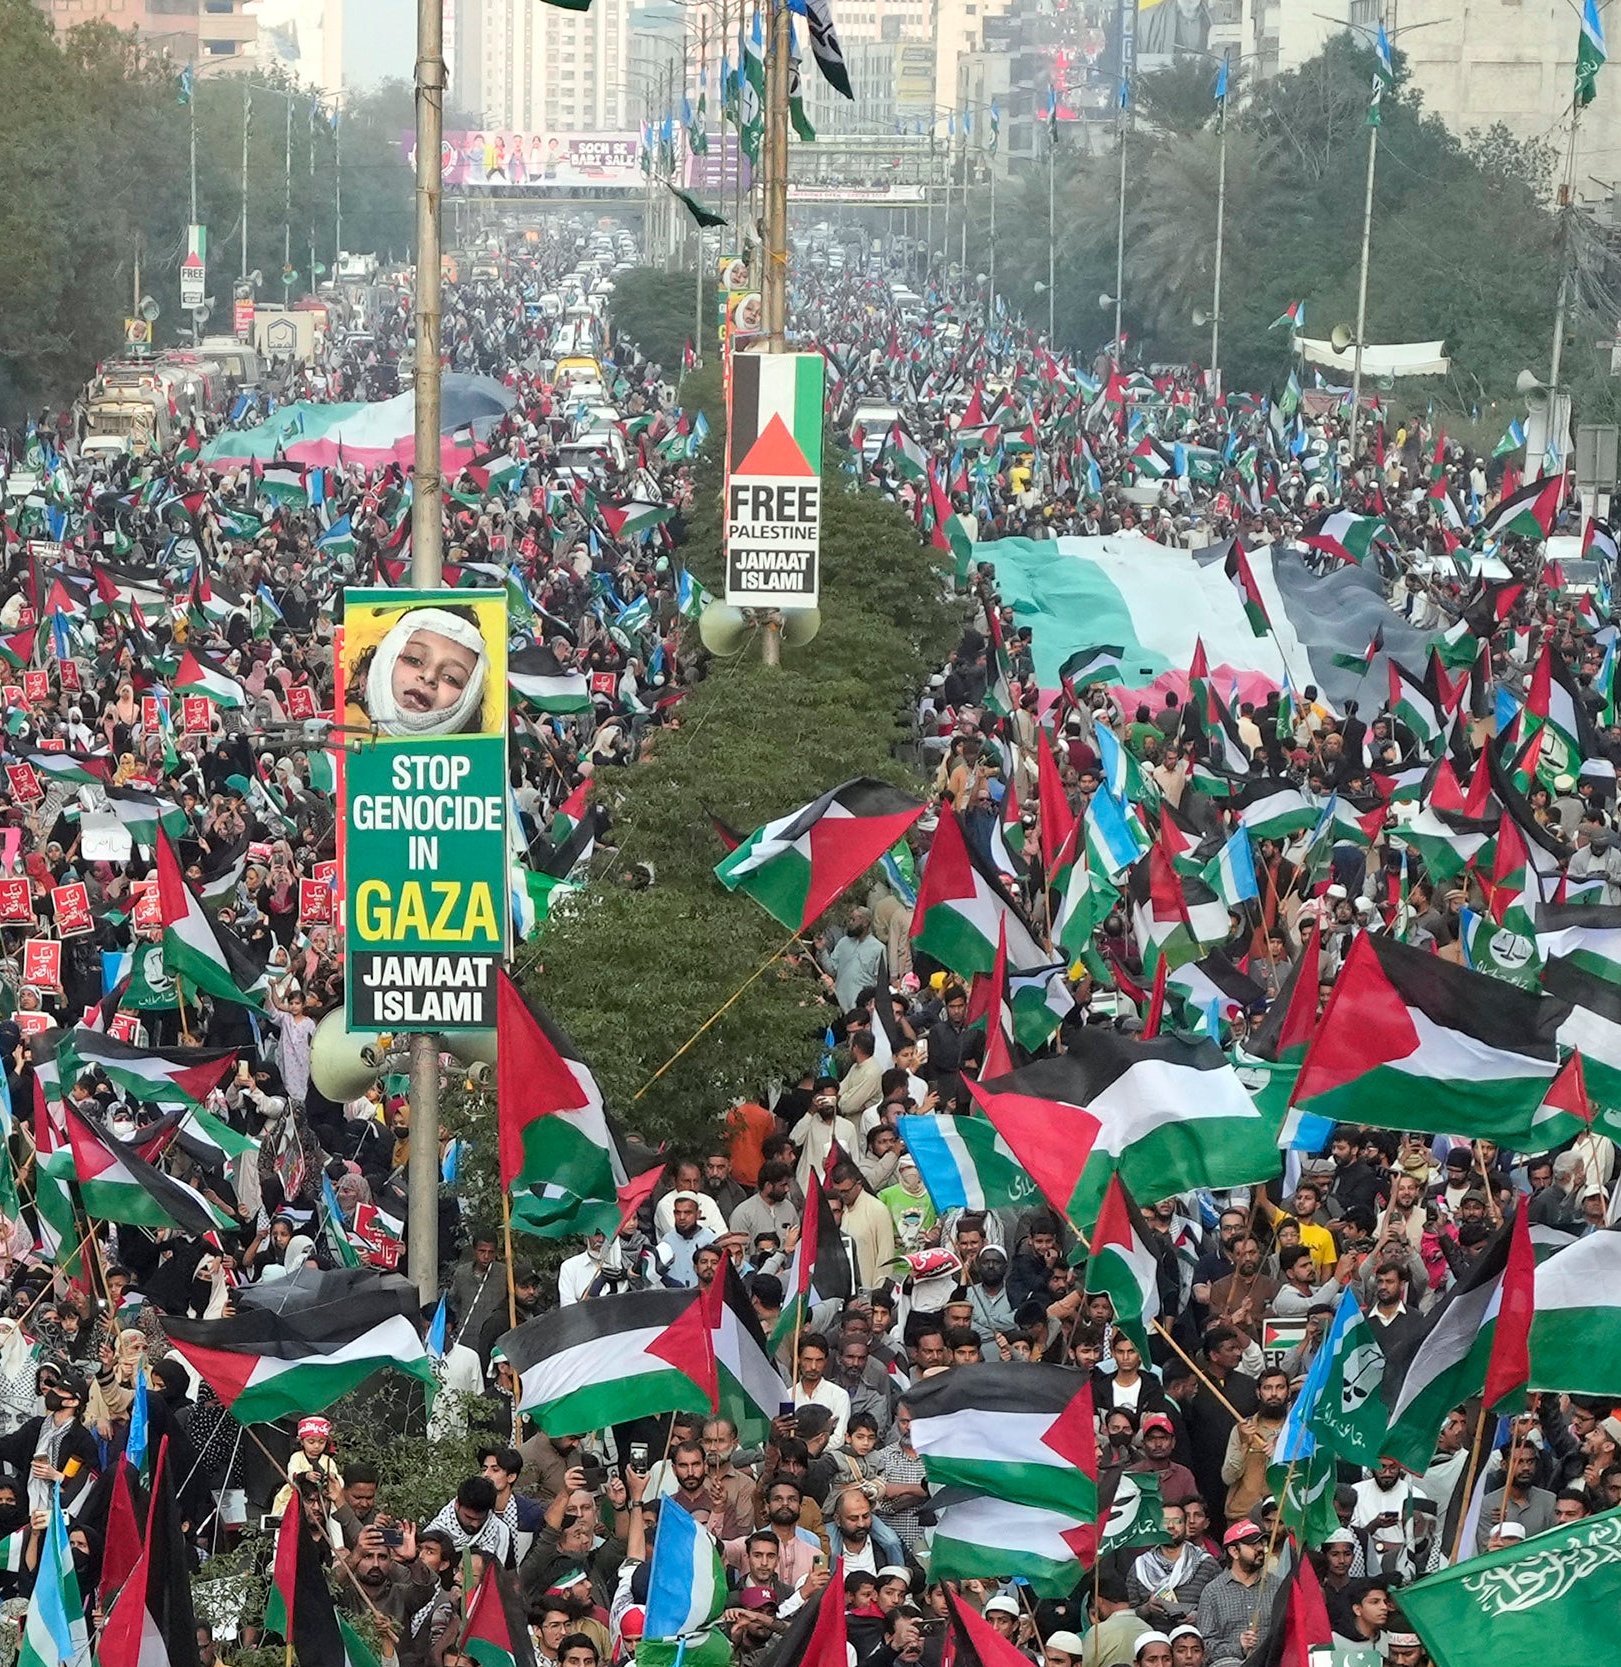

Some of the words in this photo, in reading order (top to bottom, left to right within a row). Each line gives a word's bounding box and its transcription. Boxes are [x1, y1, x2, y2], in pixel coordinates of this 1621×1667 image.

[182, 268, 204, 279] FREE
[730, 485, 818, 522] FREE
[729, 525, 818, 541] PALESTINE
[735, 551, 810, 571] JAMAAT
[741, 570, 804, 591] ISLAMI
[391, 755, 471, 791] STOP
[352, 795, 503, 832] GENOCIDE
[408, 836, 439, 872] IN
[355, 879, 500, 942] GAZA
[362, 956, 494, 988] JAMAAT
[373, 991, 483, 1022] ISLAMI
